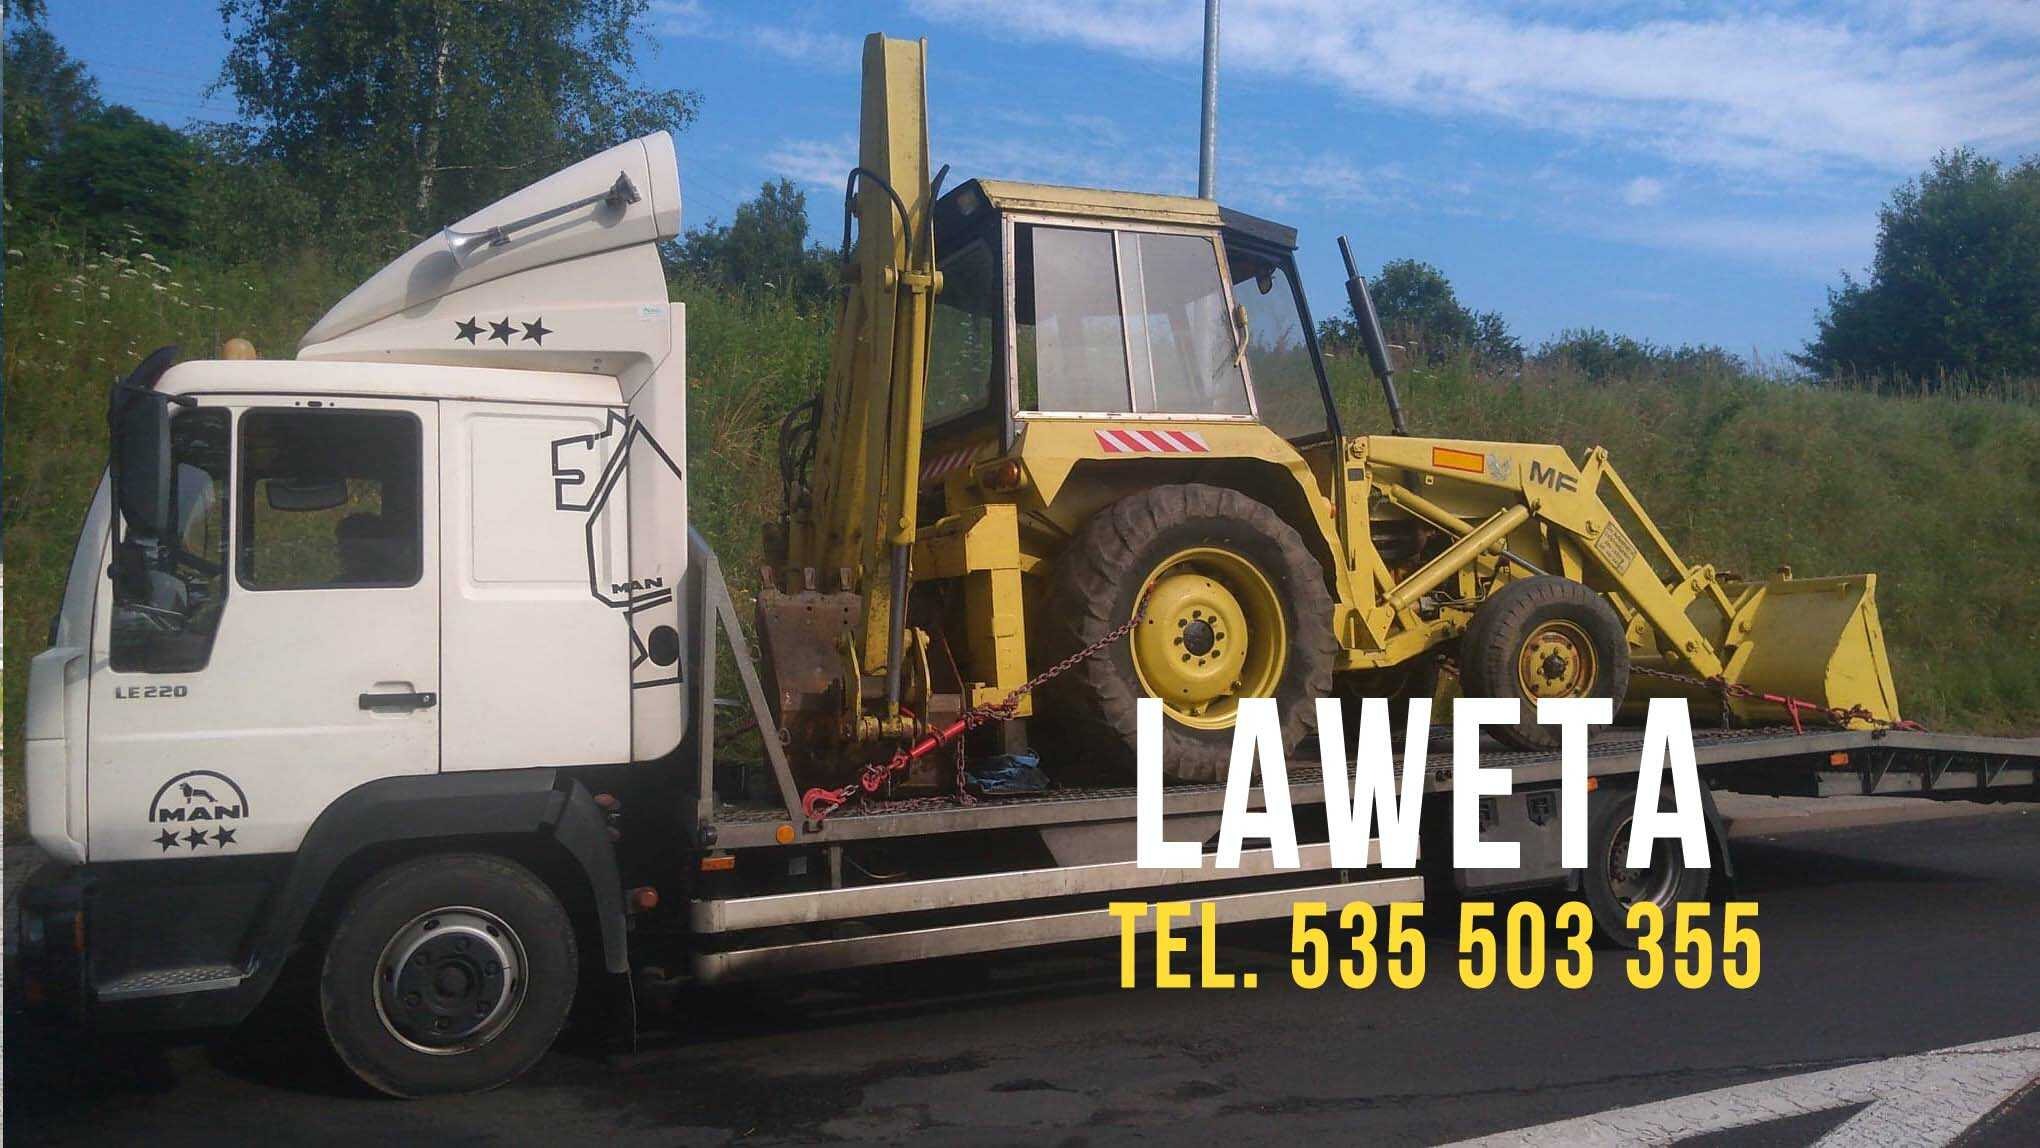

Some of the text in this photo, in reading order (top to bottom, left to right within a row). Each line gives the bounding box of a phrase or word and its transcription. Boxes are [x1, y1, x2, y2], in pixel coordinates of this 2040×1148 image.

[1529, 460, 1579, 493] MF
[611, 577, 663, 594] MAN
[159, 805, 241, 823] MAN
